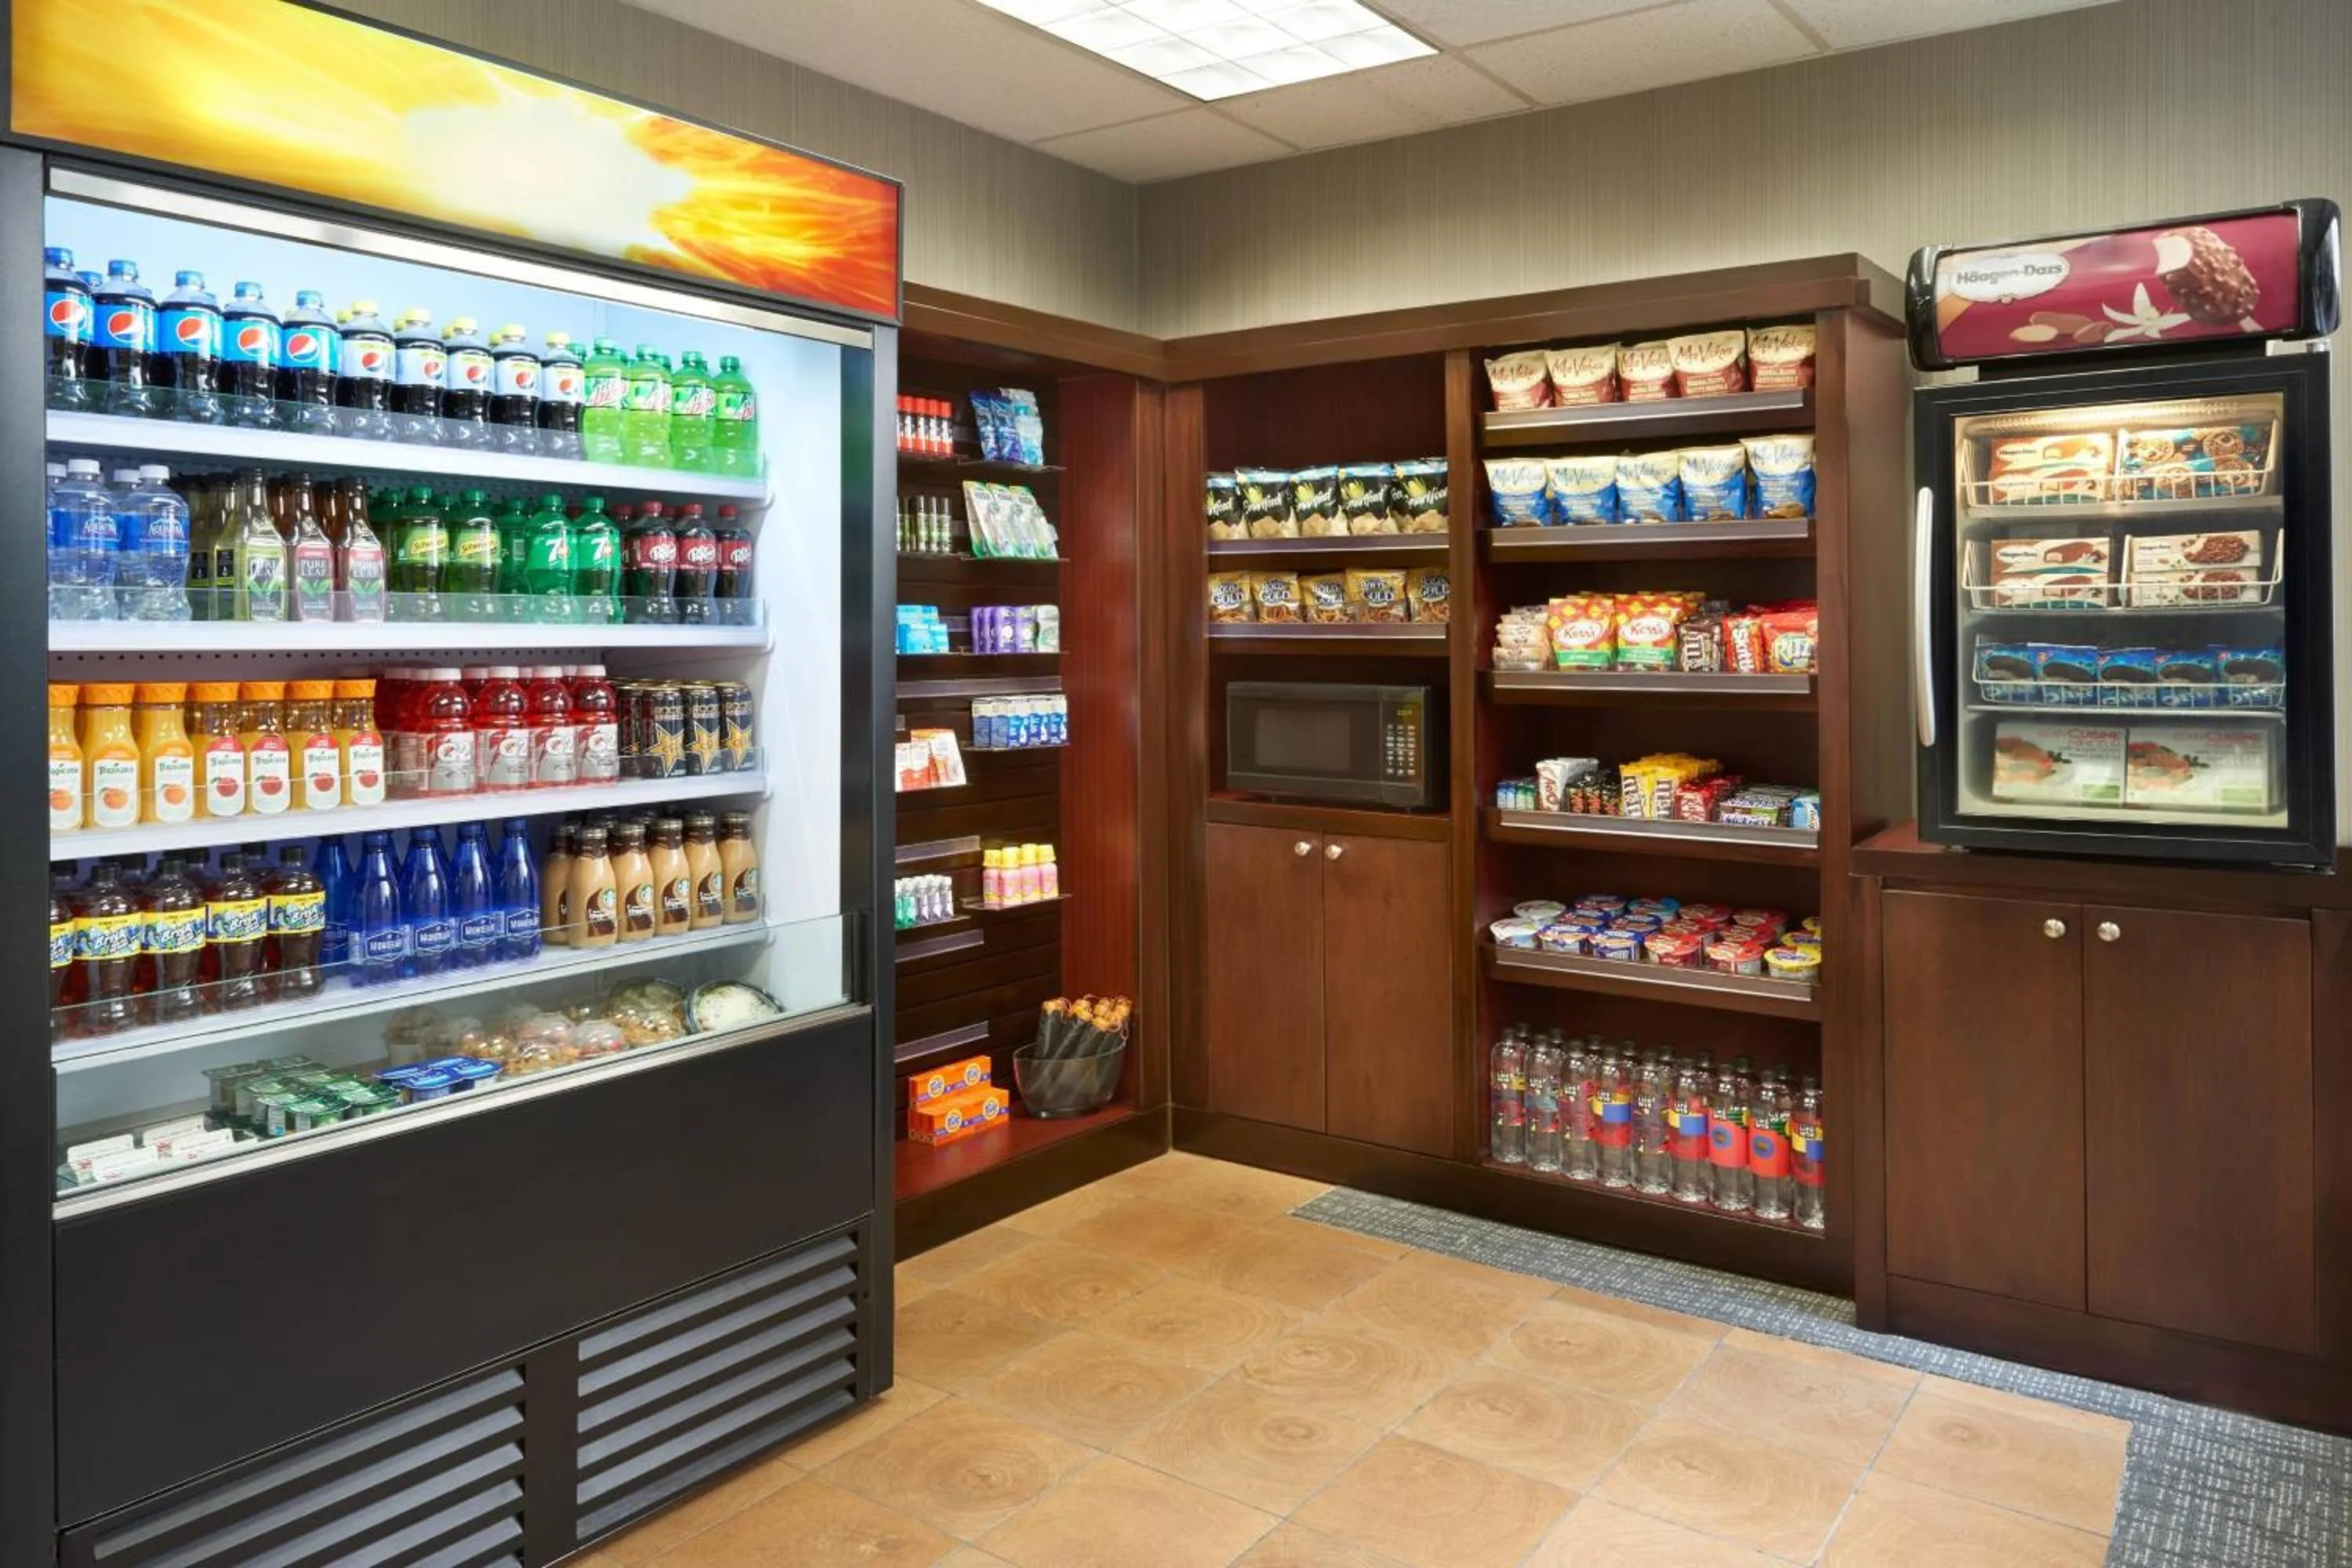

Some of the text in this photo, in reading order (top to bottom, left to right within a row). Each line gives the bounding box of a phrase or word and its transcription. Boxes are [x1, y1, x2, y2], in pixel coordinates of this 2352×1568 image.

[300, 559, 327, 568] PURE
[300, 568, 327, 576] LEAF
[437, 742, 470, 761] G2
[499, 738, 529, 757] G2
[546, 735, 575, 754] G2
[589, 733, 617, 753] G2
